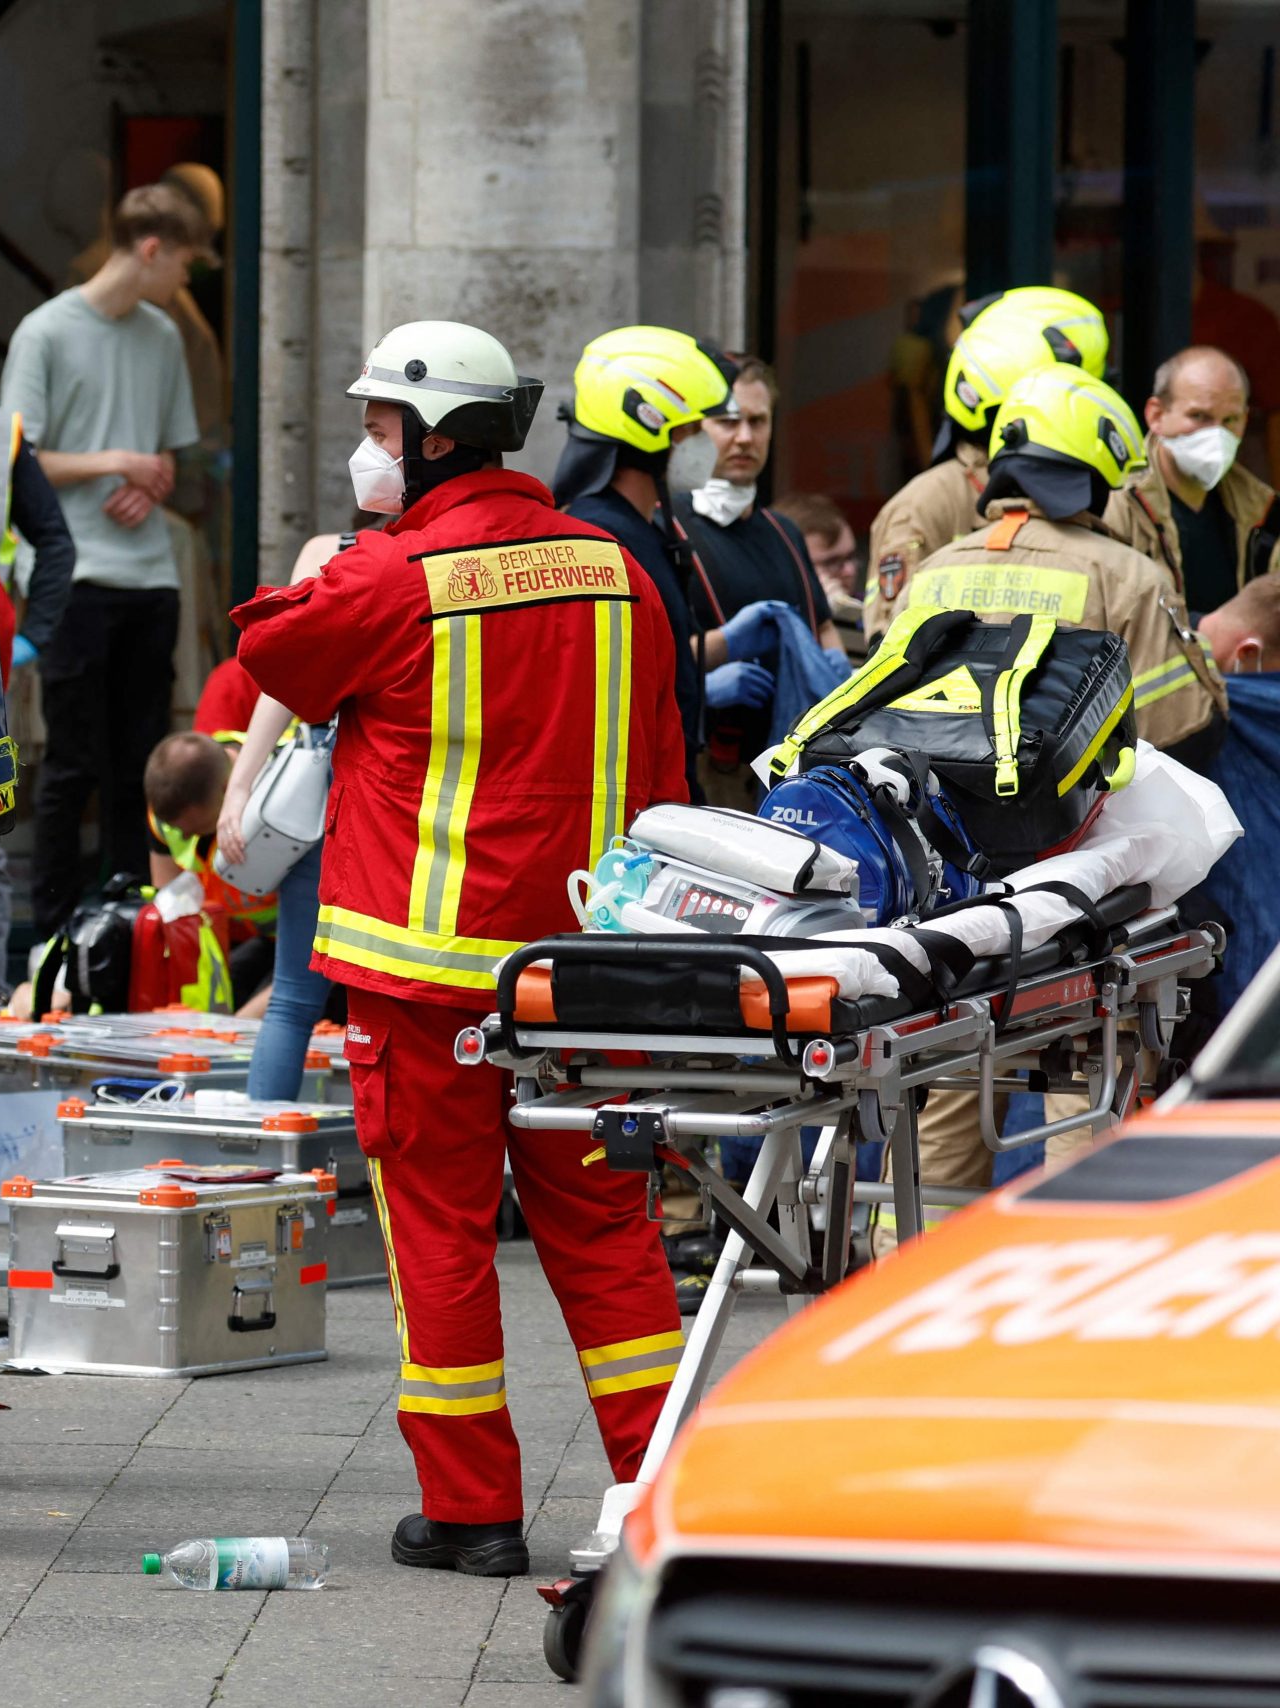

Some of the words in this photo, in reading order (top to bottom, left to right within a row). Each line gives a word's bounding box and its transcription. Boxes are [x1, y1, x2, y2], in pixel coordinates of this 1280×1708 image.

[499, 545, 577, 571] BERLINER
[503, 565, 617, 596] FEUERWEHR
[960, 587, 1063, 613] FEUERWEHR
[770, 806, 819, 826] ZOLL
